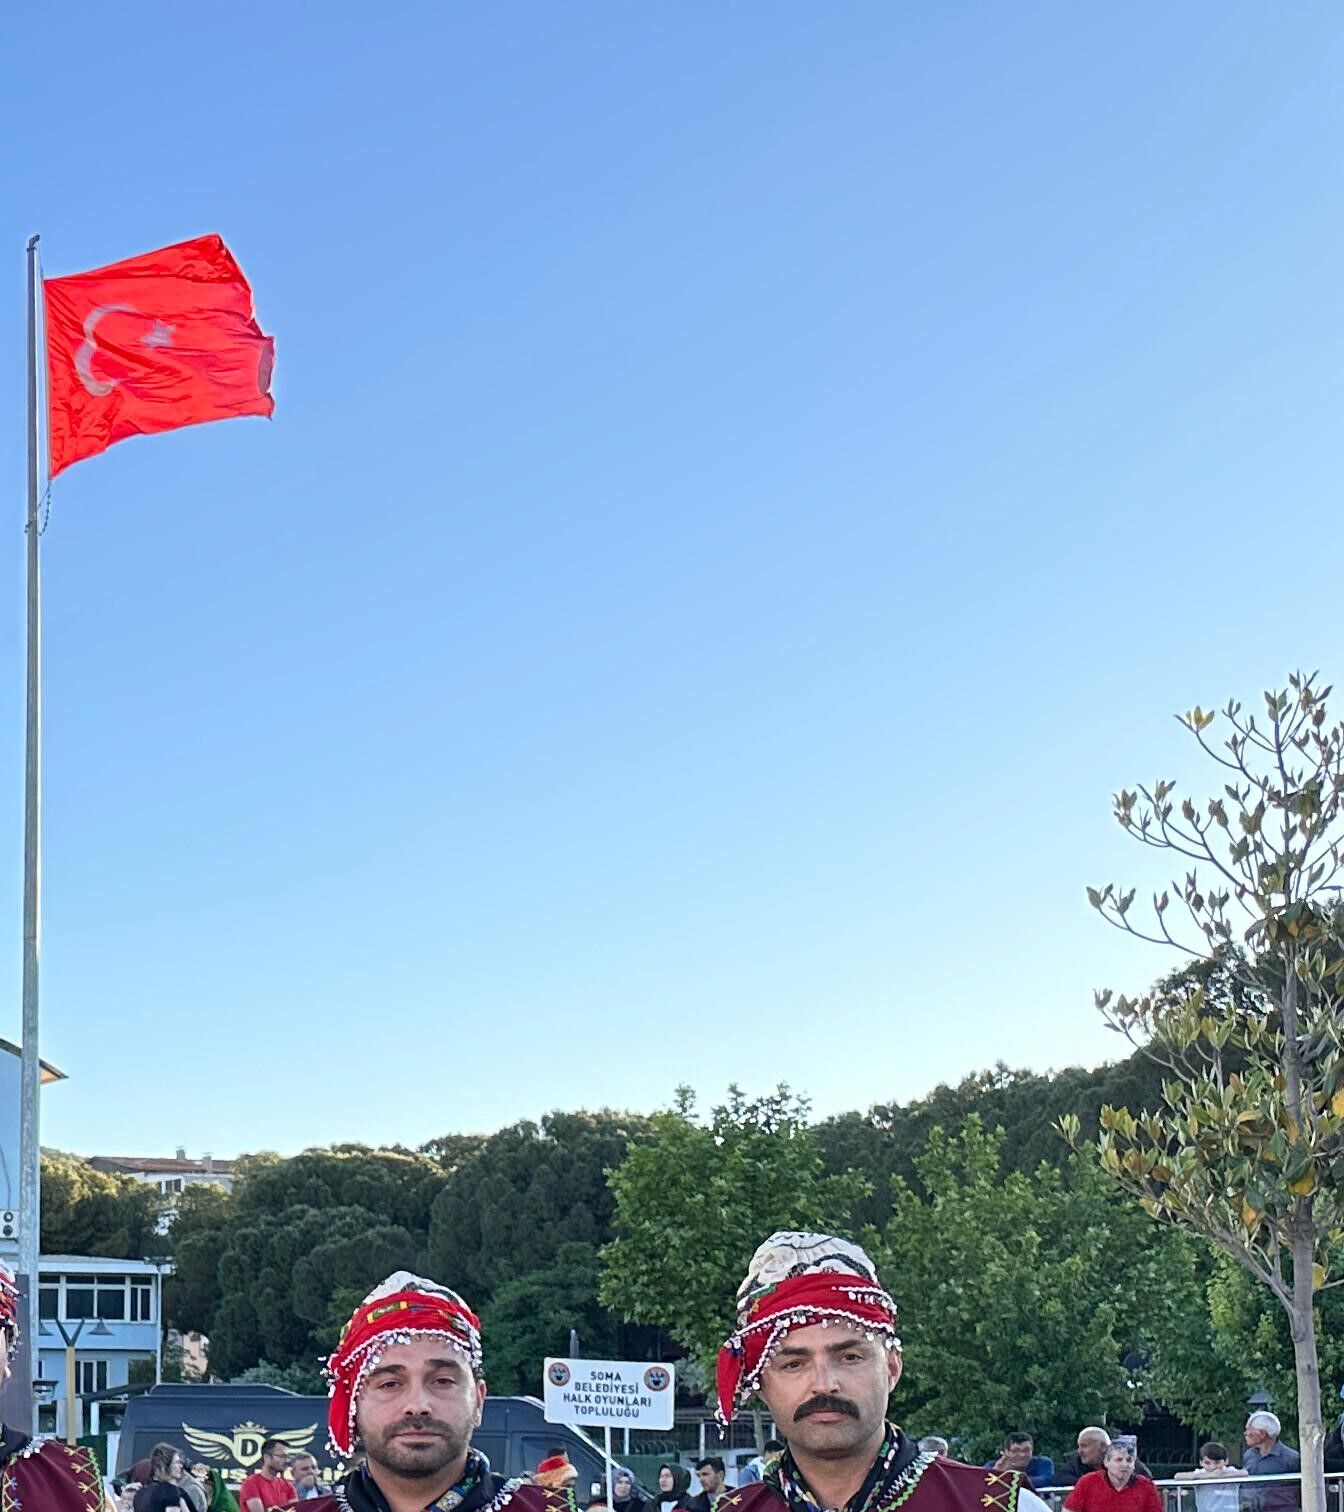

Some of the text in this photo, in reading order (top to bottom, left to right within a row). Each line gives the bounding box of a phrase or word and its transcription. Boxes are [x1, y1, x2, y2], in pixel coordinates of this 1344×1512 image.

[590, 1370, 622, 1382] SOMA
[574, 1381, 639, 1395] BELEDİYESİ
[563, 1392, 652, 1408] HALK OYUNLARI
[574, 1405, 640, 1418] TOPLULUĞU
[240, 1438, 259, 1457] D
